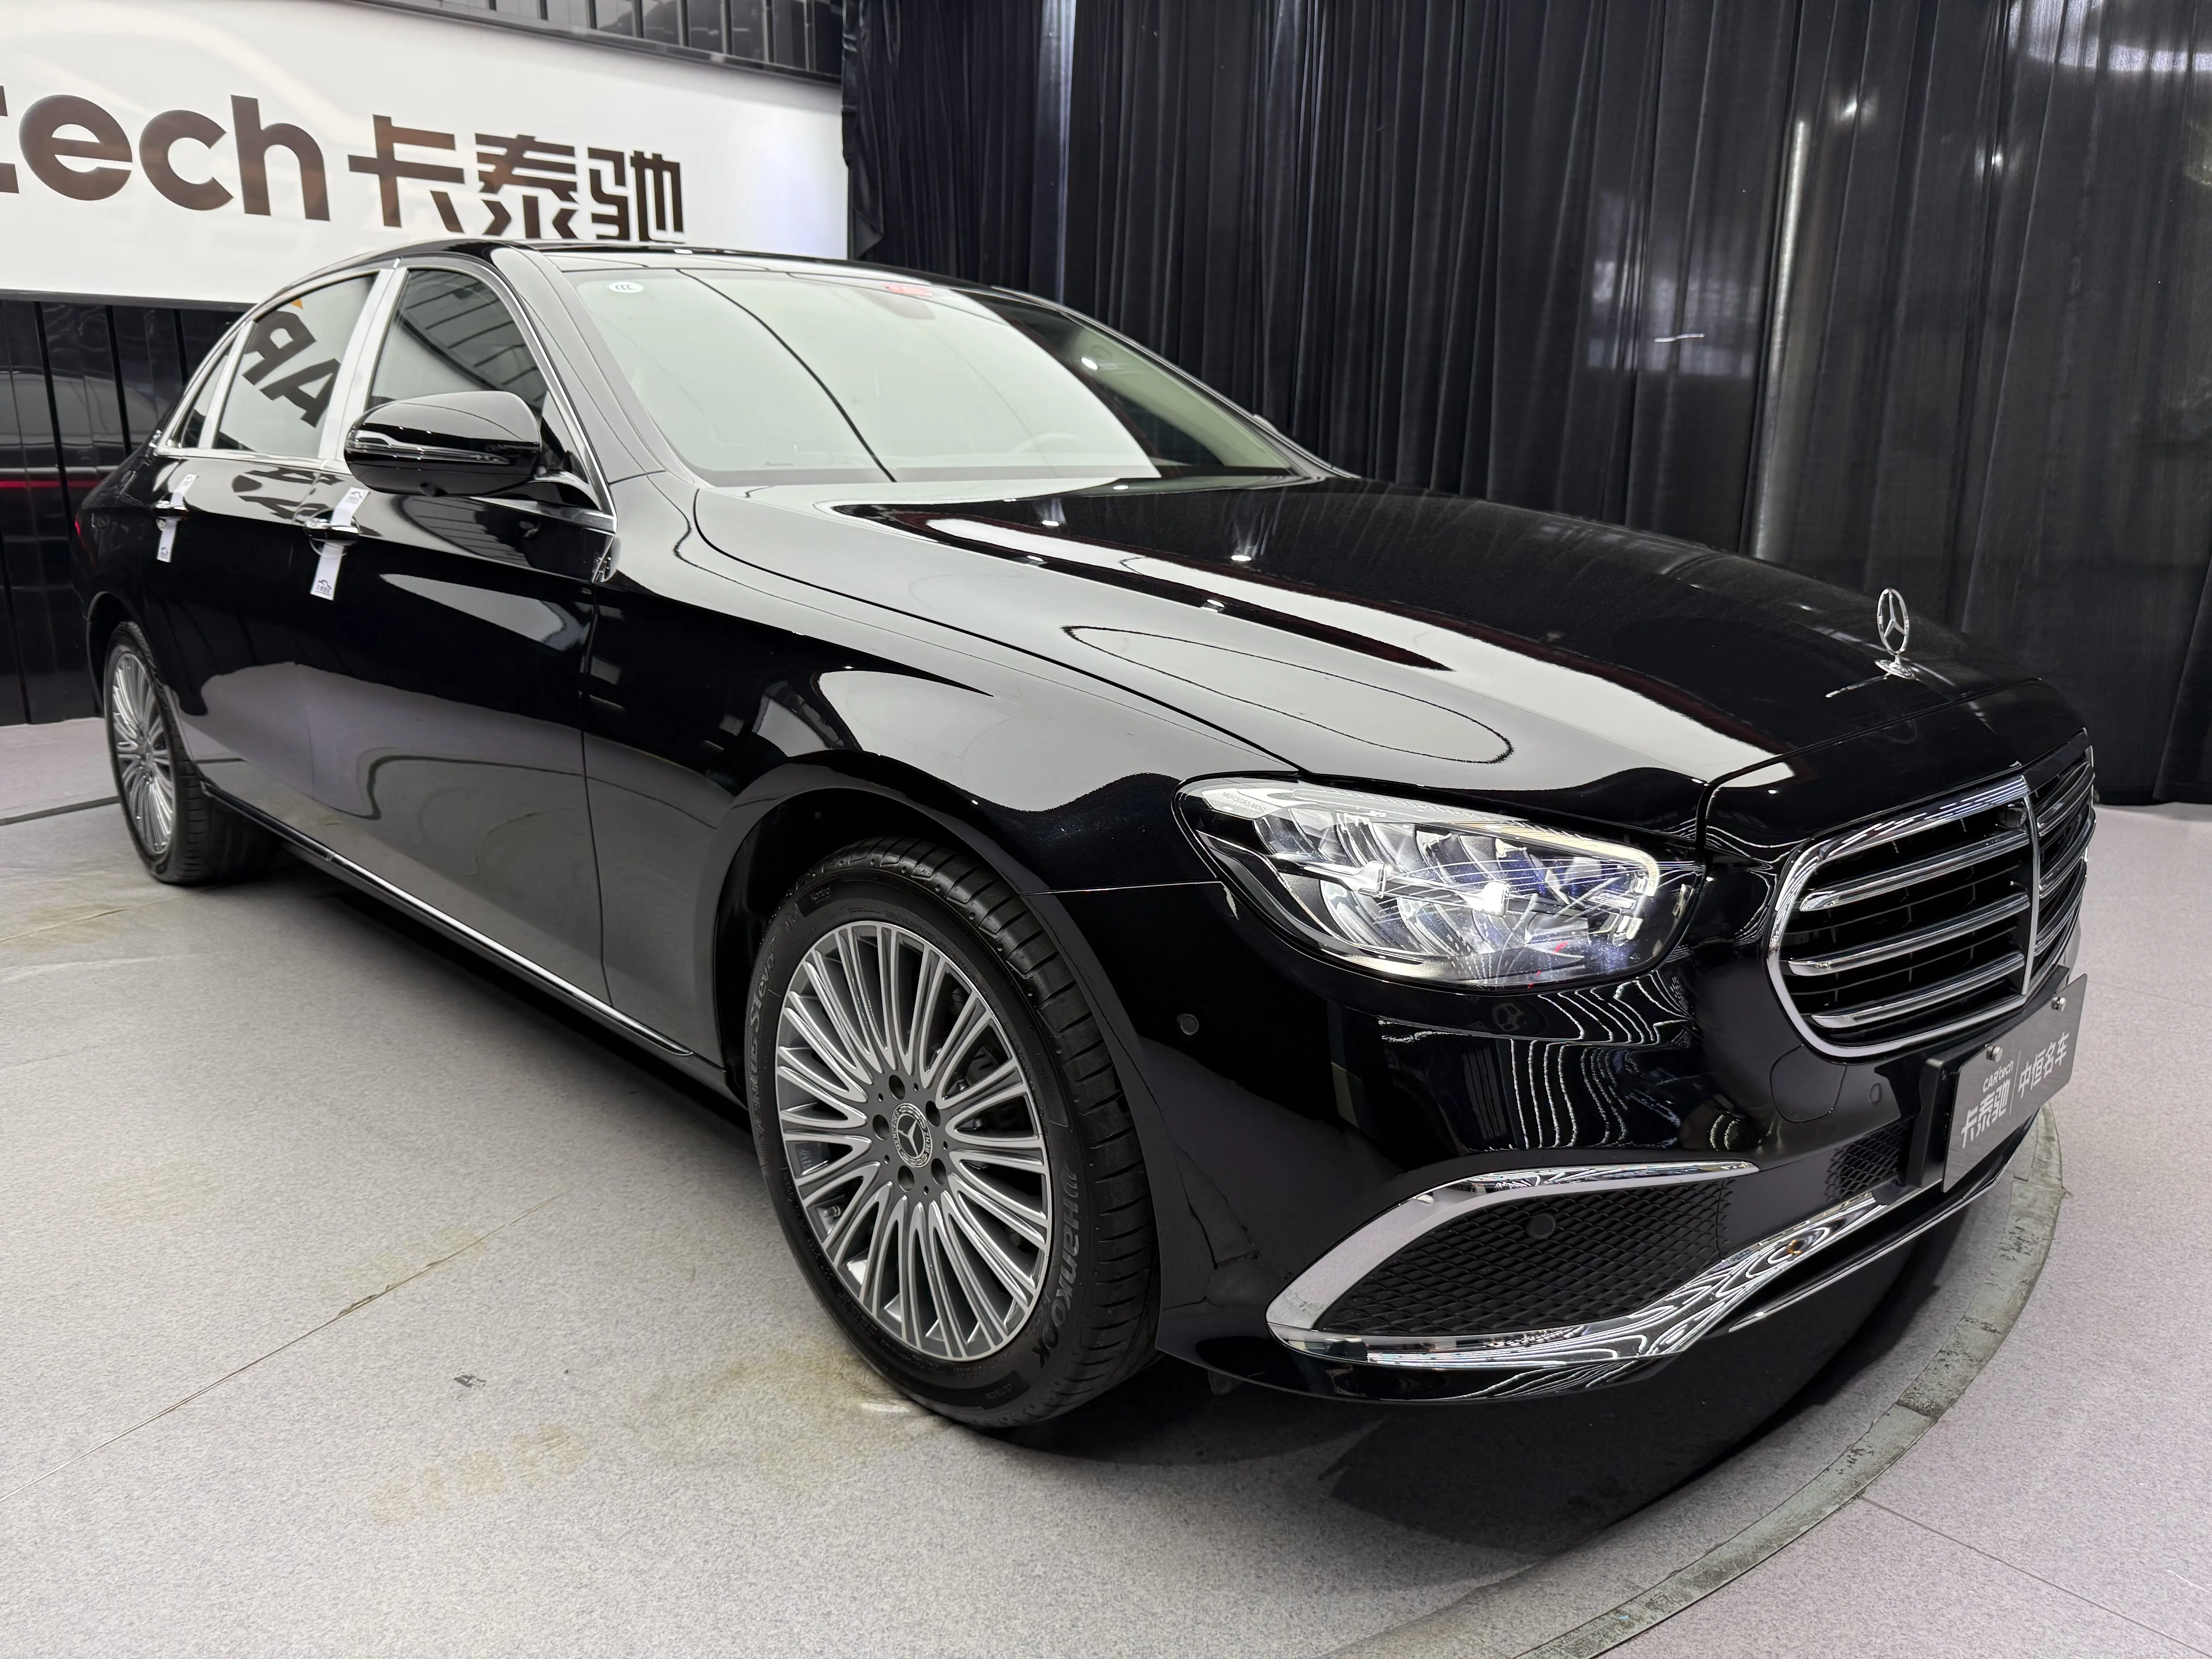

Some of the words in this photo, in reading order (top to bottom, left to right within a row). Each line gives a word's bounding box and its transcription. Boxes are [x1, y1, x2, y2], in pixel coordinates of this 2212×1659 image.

[348, 114, 684, 242] 卡泰驰
[1223, 792, 1266, 812] MERCEDES-BENZ
[1961, 1079, 2010, 1149] 卡泰驰
[2018, 1032, 2069, 1099] 中恒名车
